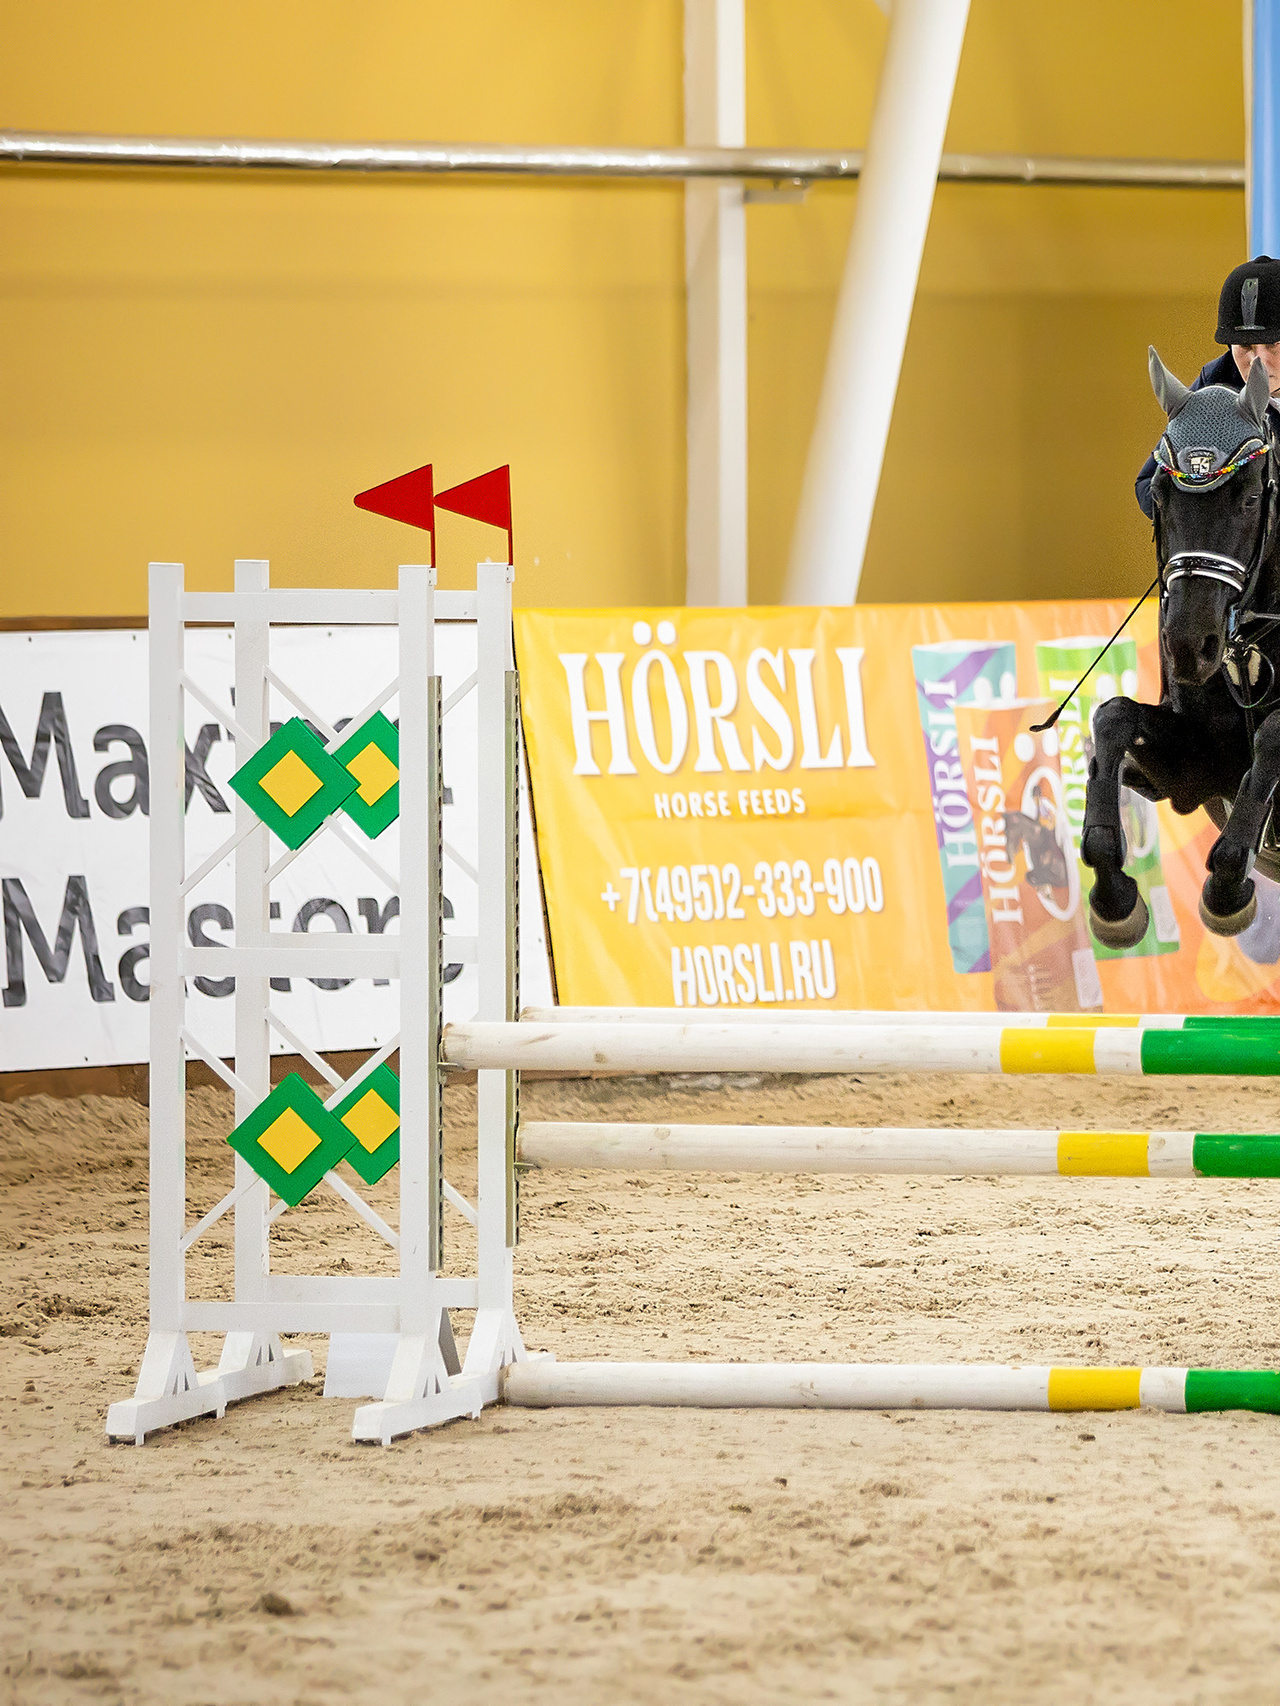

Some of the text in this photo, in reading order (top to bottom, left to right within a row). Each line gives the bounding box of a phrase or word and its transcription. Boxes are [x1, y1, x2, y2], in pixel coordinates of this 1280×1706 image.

[558, 620, 877, 775] HÖRSLI
[654, 787, 808, 819] HORSE FEEDS
[970, 735, 1024, 926] HÖRSLI
[670, 938, 838, 1007] HORSLI.RU
